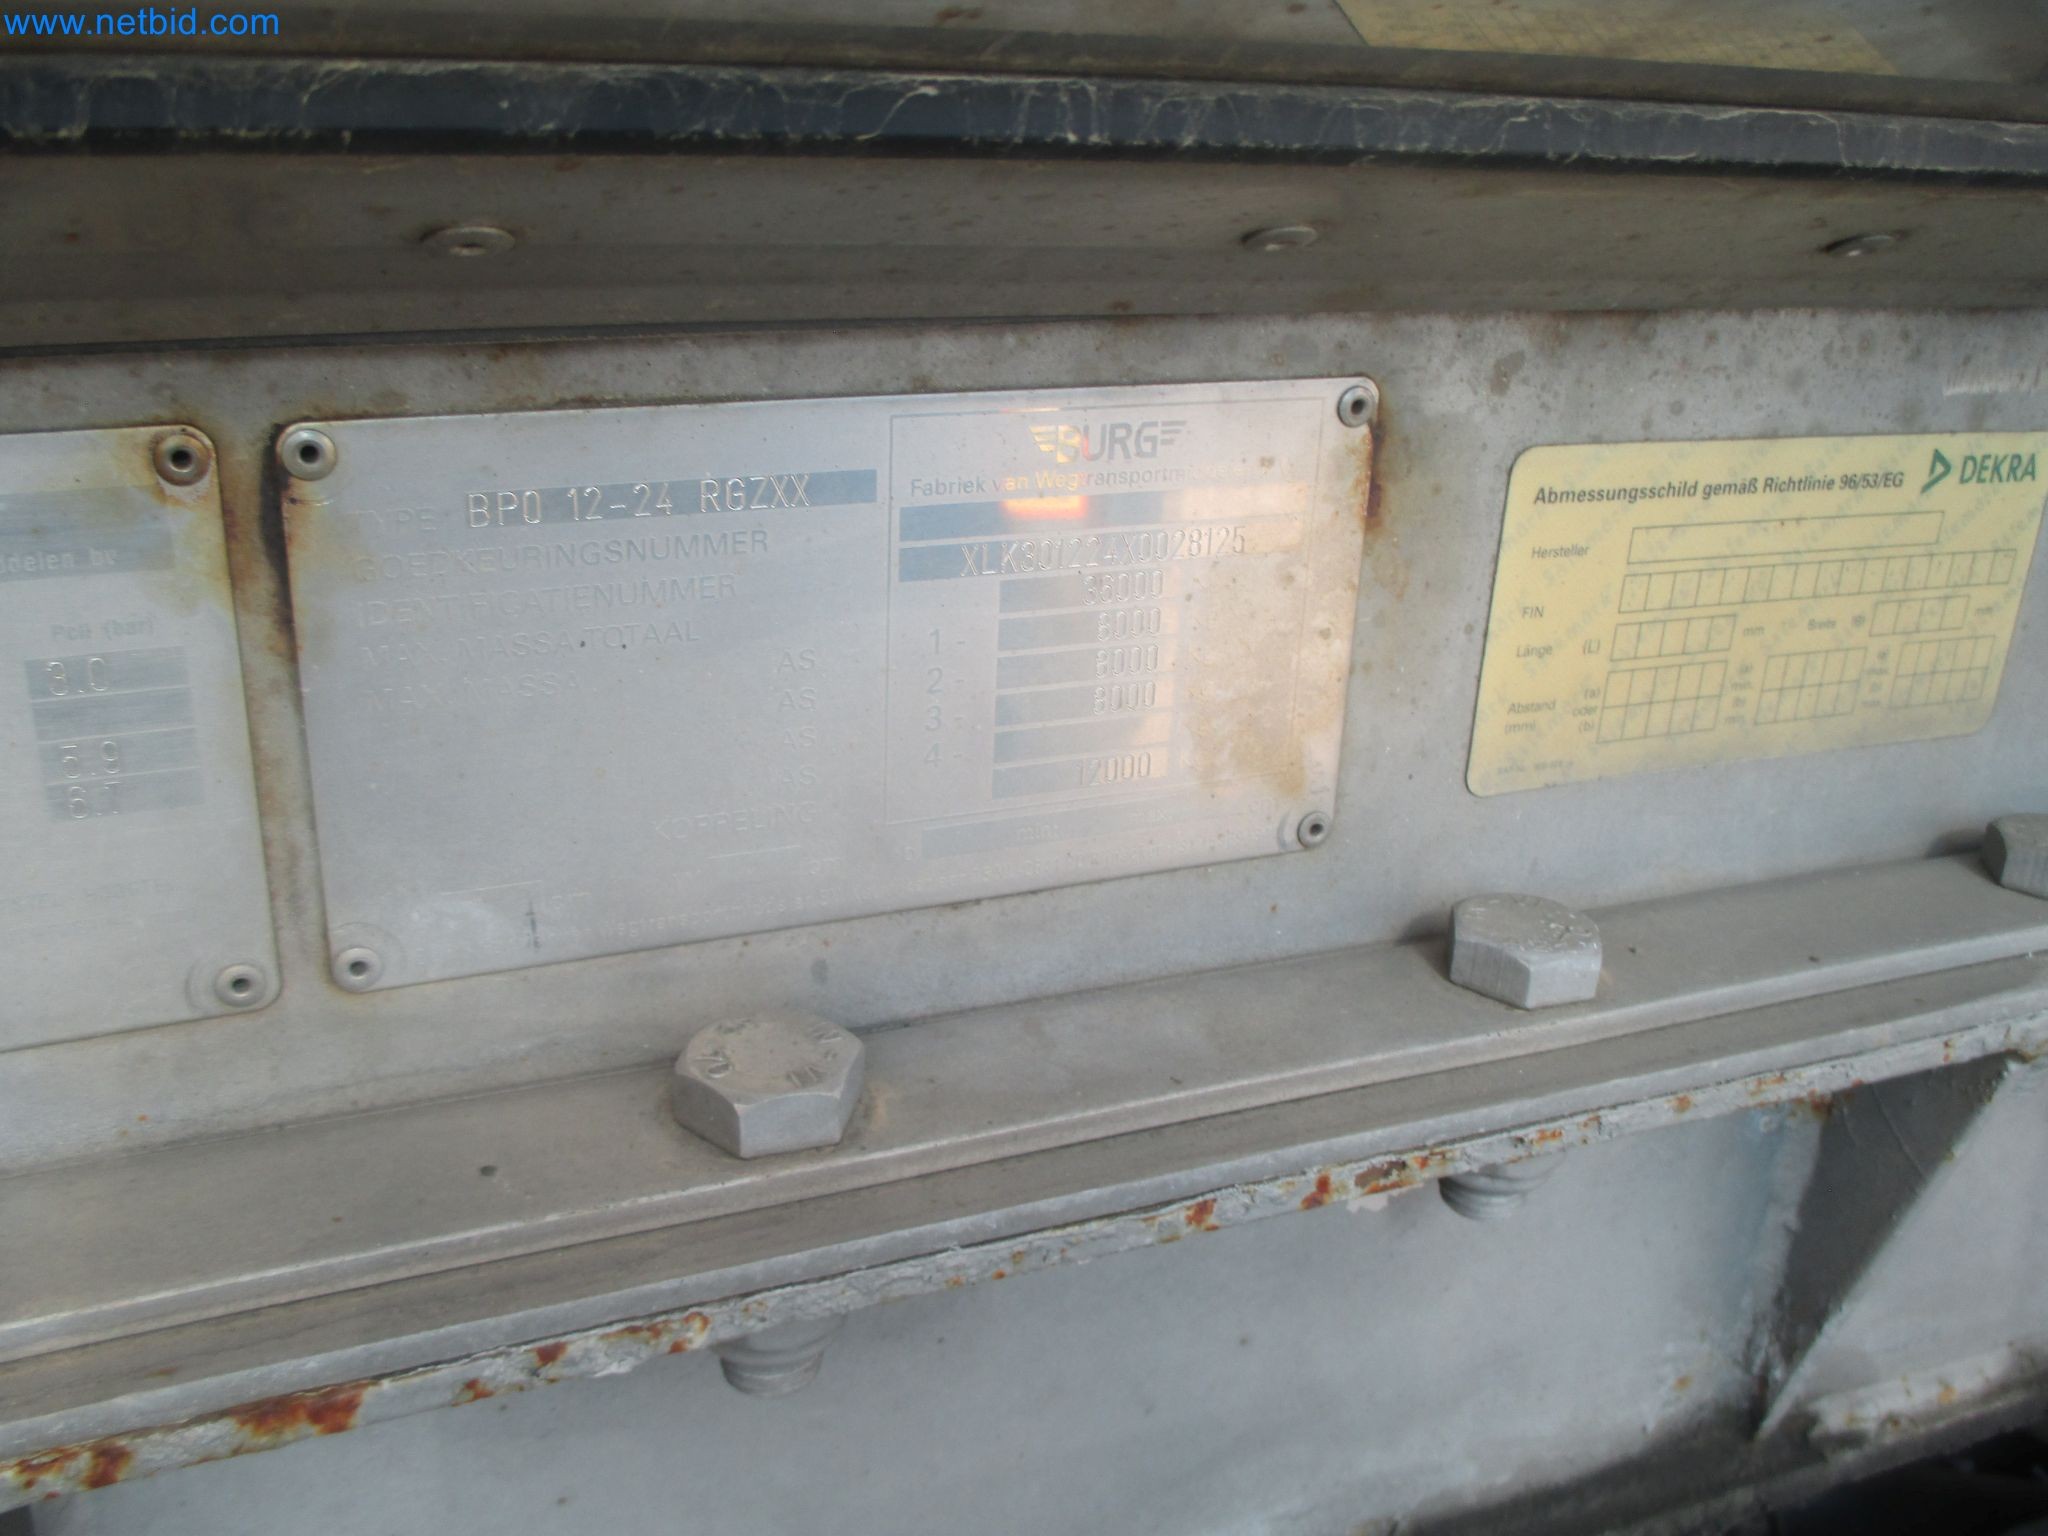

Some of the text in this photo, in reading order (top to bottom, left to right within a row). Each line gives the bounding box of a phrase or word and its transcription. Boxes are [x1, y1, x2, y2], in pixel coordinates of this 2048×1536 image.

[1055, 422, 1160, 463] BURG
[1958, 453, 2037, 485] DEKRA
[566, 483, 673, 521] 12-24
[700, 473, 811, 513] RGZXX
[910, 477, 986, 497] Fabriek
[992, 475, 1029, 492] van
[1533, 471, 1905, 504] Abmessungsschild gemäß Richtlinie 96/53/EG
[354, 529, 769, 582] GOEDKEURINGSNUMMER
[1531, 544, 1590, 560] Hersteller
[357, 573, 737, 629] IDENTIFICATIENUMMER
[1521, 606, 1545, 619] FIN
[1516, 643, 1553, 659] Länge
[45, 656, 109, 697] 3.0
[926, 667, 944, 694] 2
[924, 705, 942, 732] 3
[1507, 699, 1557, 715] Abstand
[923, 742, 942, 768] 4
